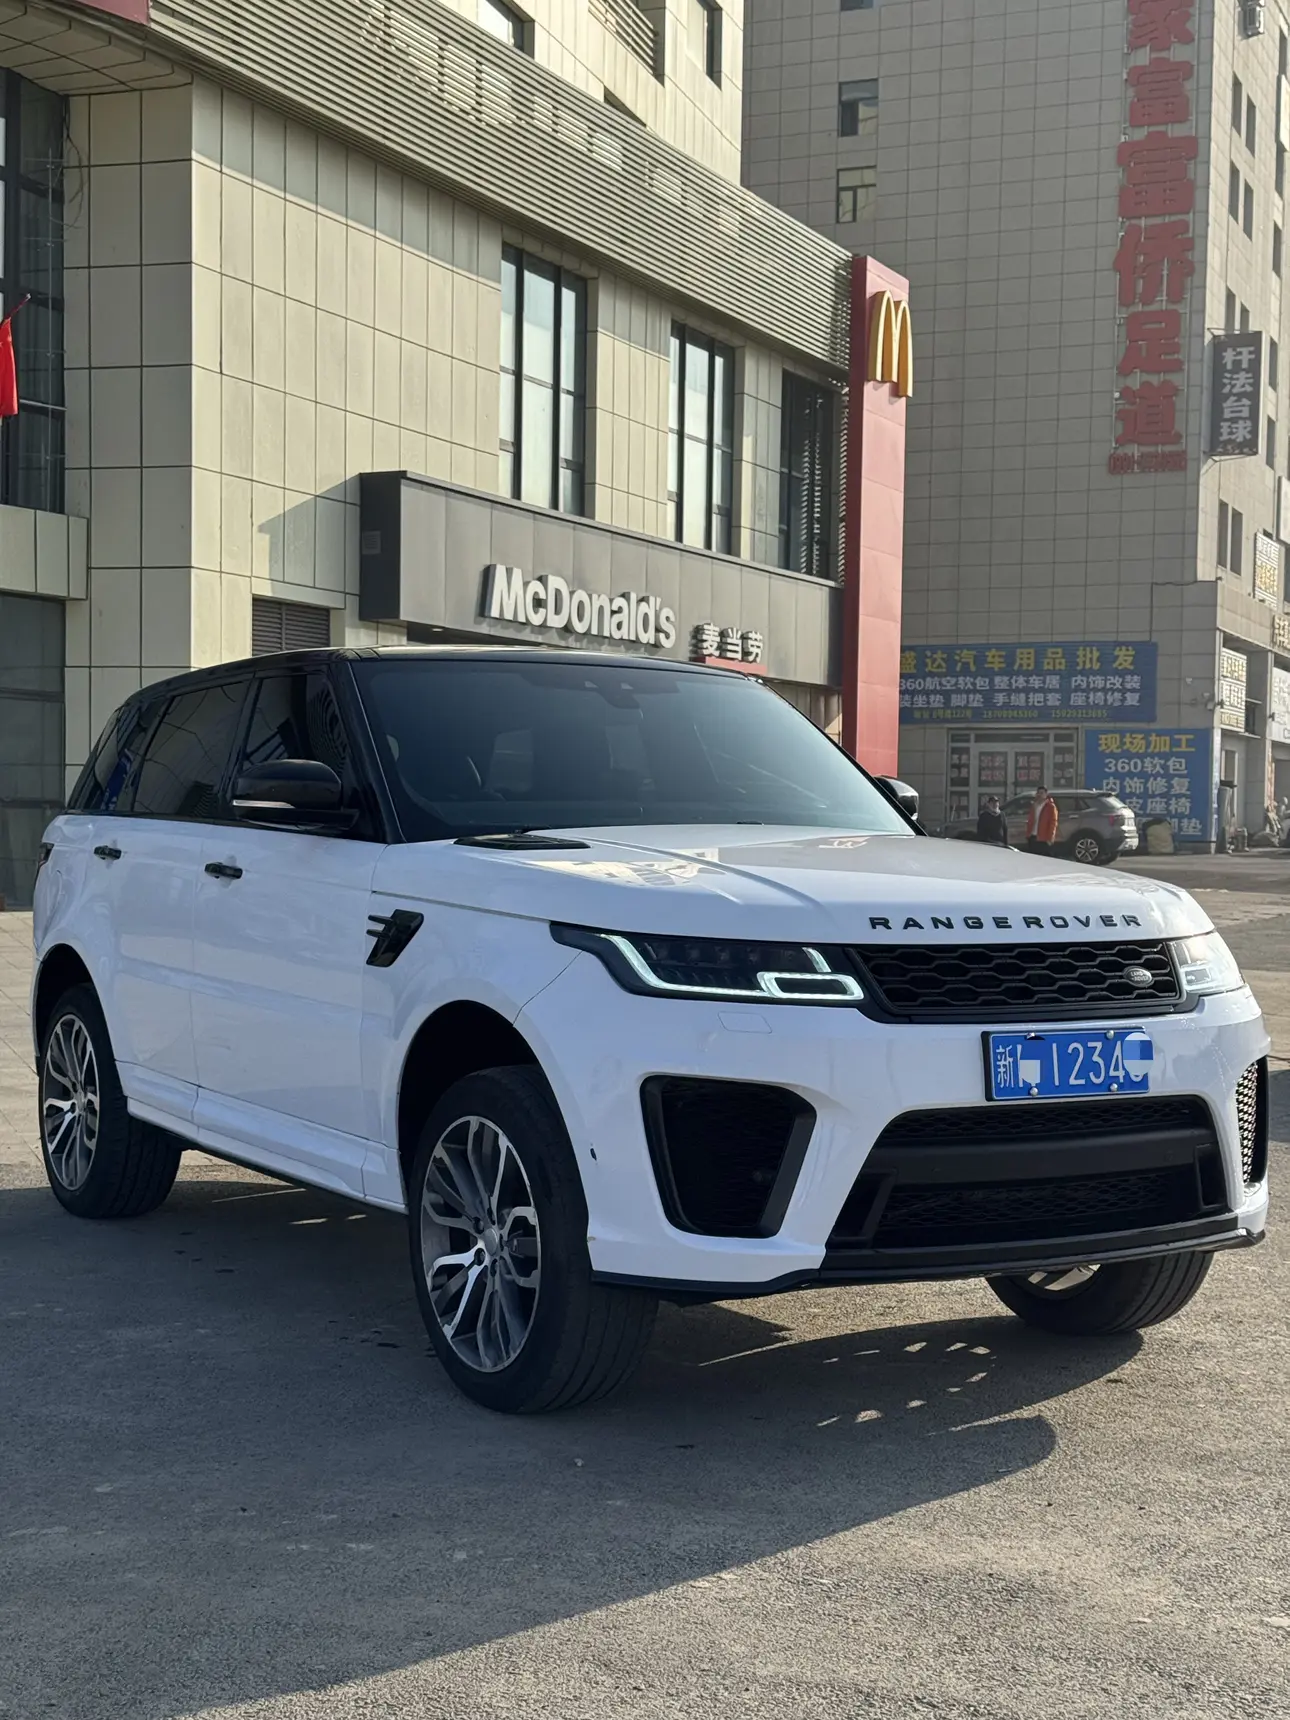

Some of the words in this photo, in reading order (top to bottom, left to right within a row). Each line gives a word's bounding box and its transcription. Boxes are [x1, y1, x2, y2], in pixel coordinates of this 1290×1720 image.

[1218, 346, 1256, 443] 杆法台球
[485, 563, 676, 649] McDonald's
[699, 622, 763, 663] 麦当劳
[1071, 674, 1141, 690] 内饰改装
[1070, 691, 1140, 707] 座椅修复
[1098, 732, 1196, 753] 现场加工
[1103, 756, 1188, 774] 360软包
[1102, 777, 1191, 795] 内饰修复
[1124, 797, 1192, 815] 皮座椅
[868, 916, 1013, 930] RANGE
[1022, 914, 1143, 929] ROVER
[995, 1039, 1150, 1088] 新1234
